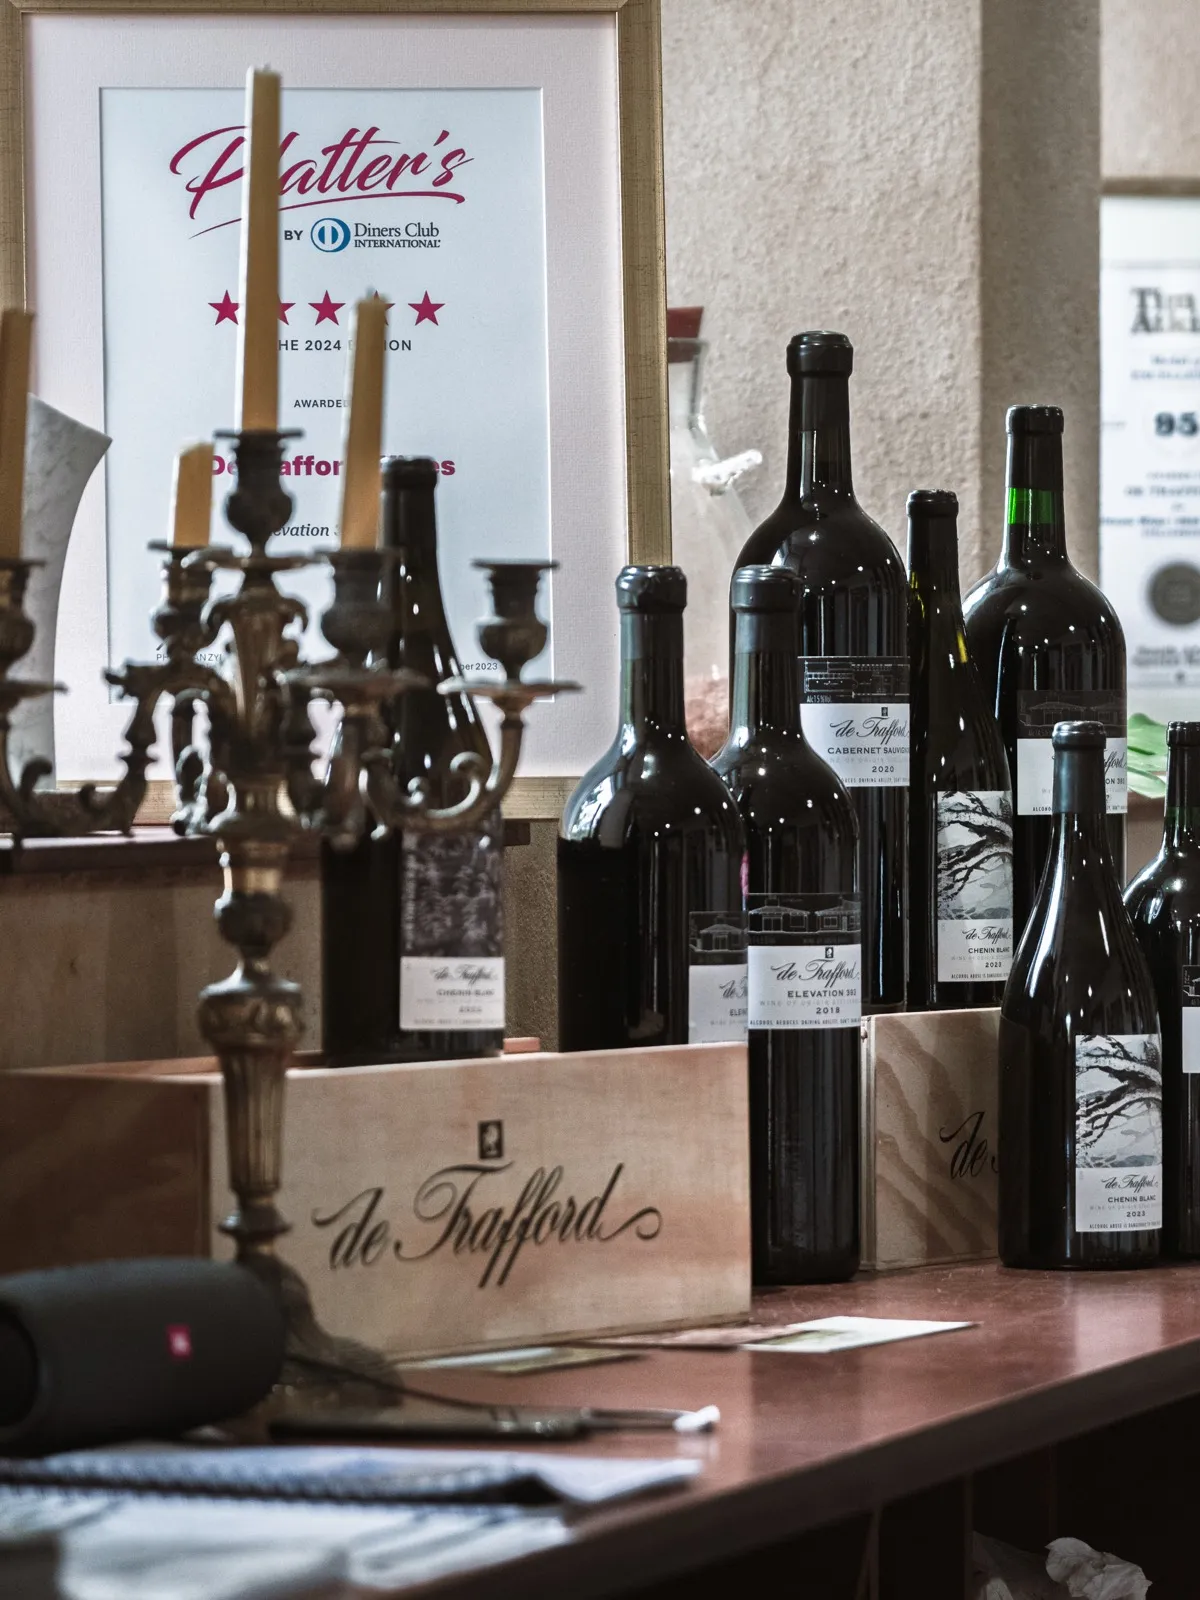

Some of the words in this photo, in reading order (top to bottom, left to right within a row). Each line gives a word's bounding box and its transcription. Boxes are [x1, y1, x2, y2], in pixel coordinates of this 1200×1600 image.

[284, 230, 303, 241] BY
[354, 222, 401, 237] Diners
[405, 222, 439, 237] Club
[354, 239, 441, 248] INTERNATIONAL
[278, 339, 299, 351] HE
[304, 339, 342, 351] 2024
[1155, 412, 1199, 437] 95
[280, 455, 343, 476] affor
[475, 663, 498, 671] 2023
[830, 719, 856, 737] de
[827, 747, 881, 755] CABERNET
[962, 928, 978, 940] de
[771, 962, 797, 980] de
[798, 958, 860, 988] Trafford
[787, 989, 844, 998] ELEVATION
[816, 1006, 841, 1014] 2018
[938, 1111, 988, 1180] de
[1101, 1177, 1118, 1189] de
[1118, 1174, 1159, 1194] Trafford
[310, 1186, 391, 1271] de
[392, 1160, 663, 1290] Trafford
